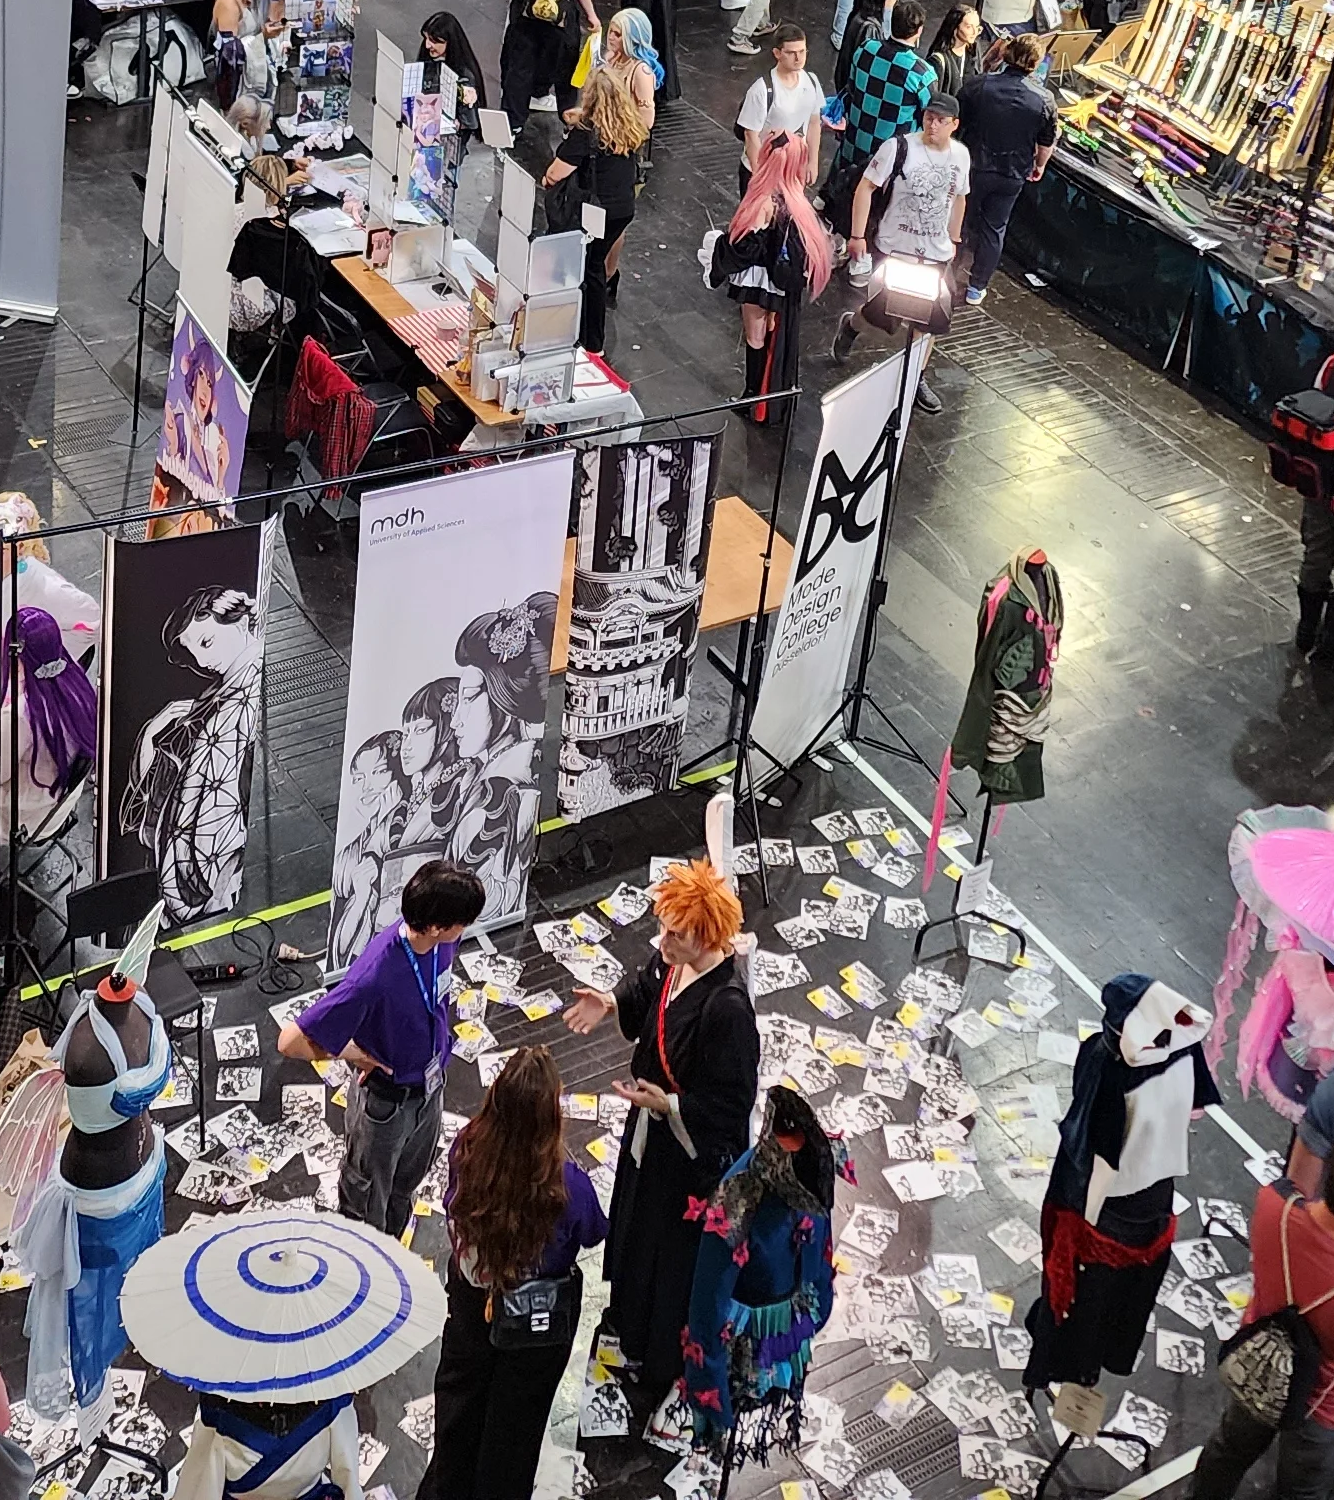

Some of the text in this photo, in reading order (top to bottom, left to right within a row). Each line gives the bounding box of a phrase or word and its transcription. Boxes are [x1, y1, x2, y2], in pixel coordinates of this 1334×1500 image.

[369, 531, 401, 546] University
[410, 524, 436, 536] Applied
[437, 519, 466, 530] Sciences
[371, 507, 424, 535] mdh
[781, 584, 842, 637] Design
[786, 566, 836, 613] Mode
[776, 605, 841, 660] College
